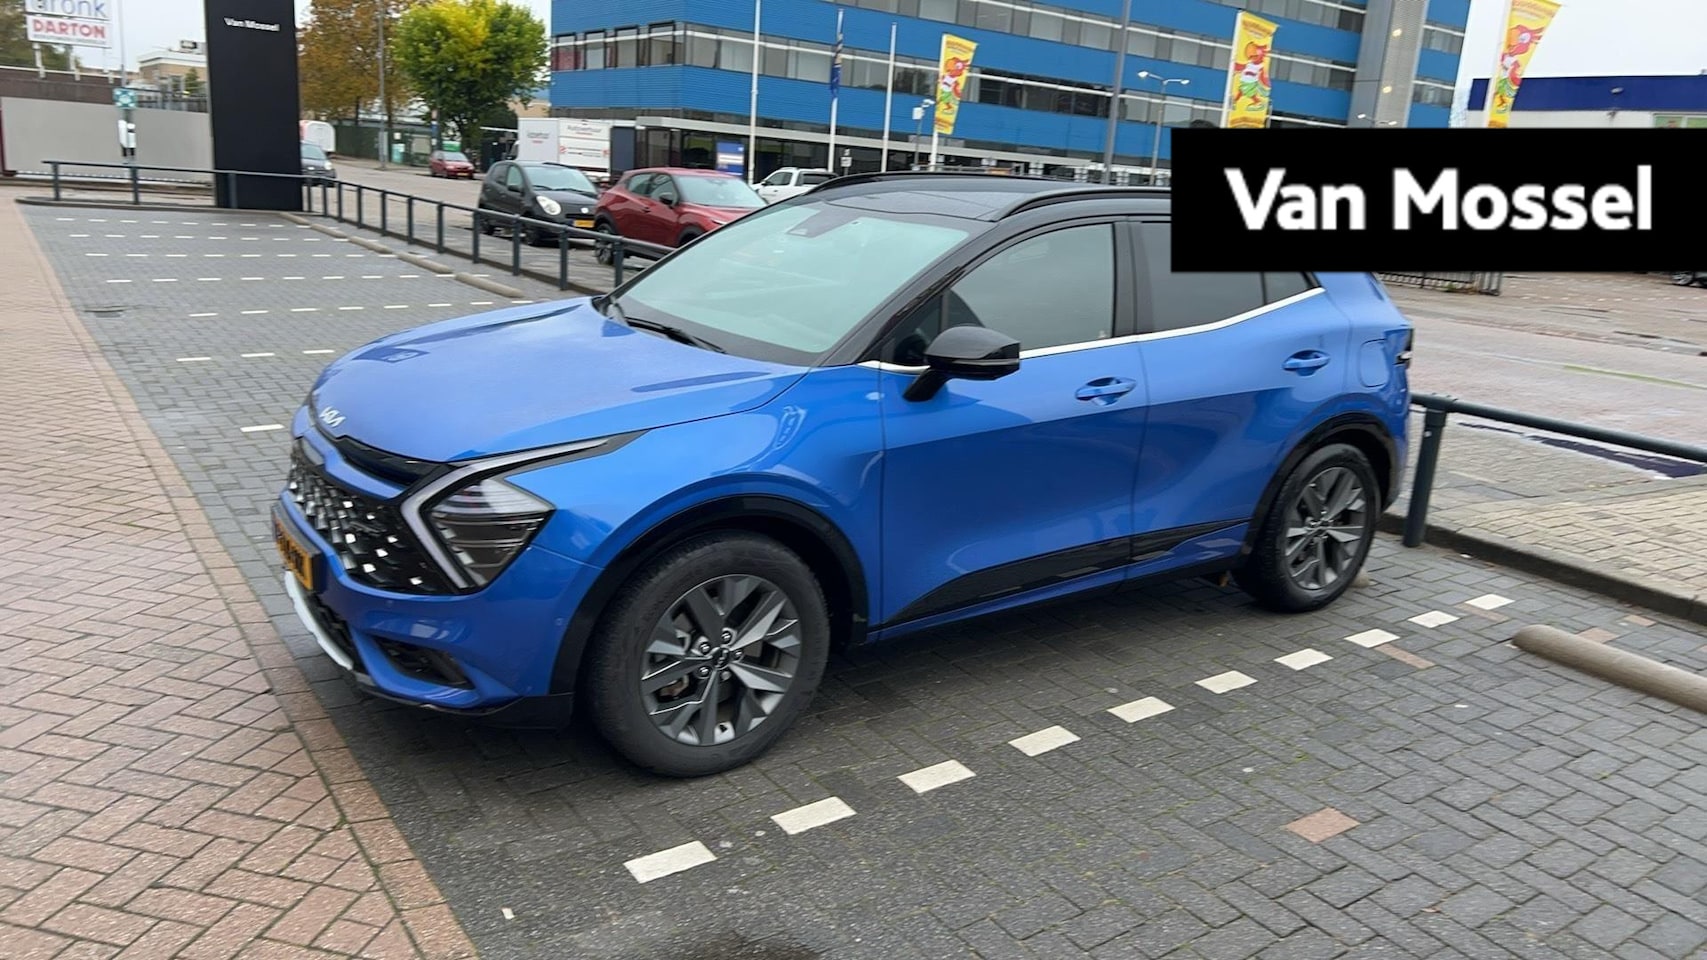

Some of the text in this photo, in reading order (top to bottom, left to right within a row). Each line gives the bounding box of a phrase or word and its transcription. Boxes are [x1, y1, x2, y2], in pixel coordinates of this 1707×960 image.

[32, 19, 105, 38] DARTON
[223, 17, 280, 32] Van Mossel
